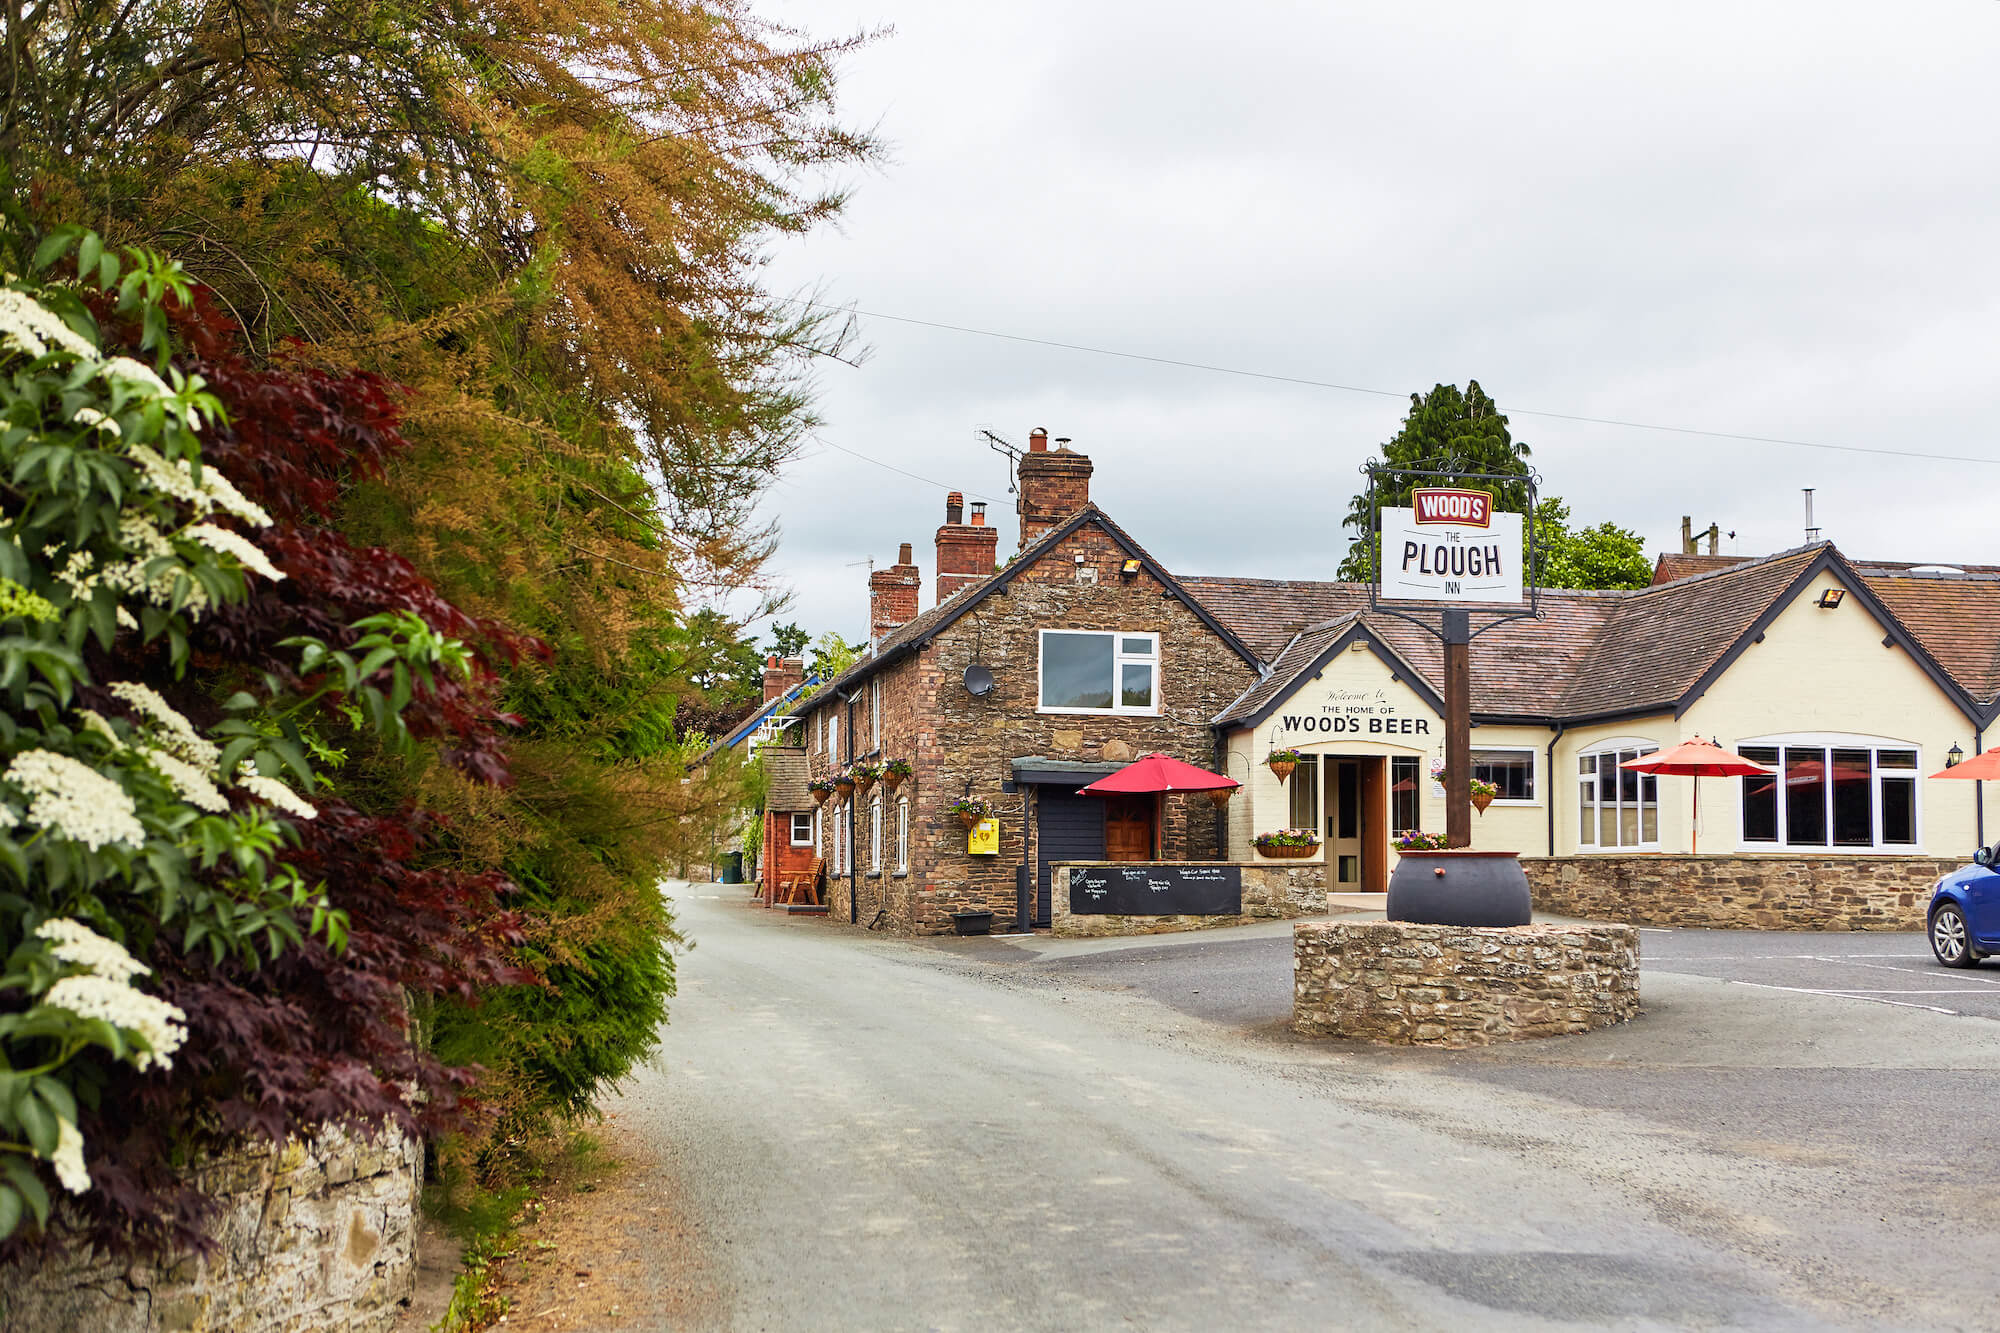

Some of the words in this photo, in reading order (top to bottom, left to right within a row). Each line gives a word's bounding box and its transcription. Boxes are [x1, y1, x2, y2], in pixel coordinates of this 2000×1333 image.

[1421, 495, 1484, 520] WOOD'S
[1445, 531, 1460, 543] THE
[1402, 541, 1501, 577] PLOUGH
[1445, 581, 1460, 595] INN
[1327, 688, 1369, 701] Welcome
[1322, 705, 1341, 714] THE
[1346, 706, 1374, 714] HOME
[1380, 707, 1395, 715] OF
[1283, 715, 1360, 733] WOOD'S
[1369, 718, 1430, 735] BEER
